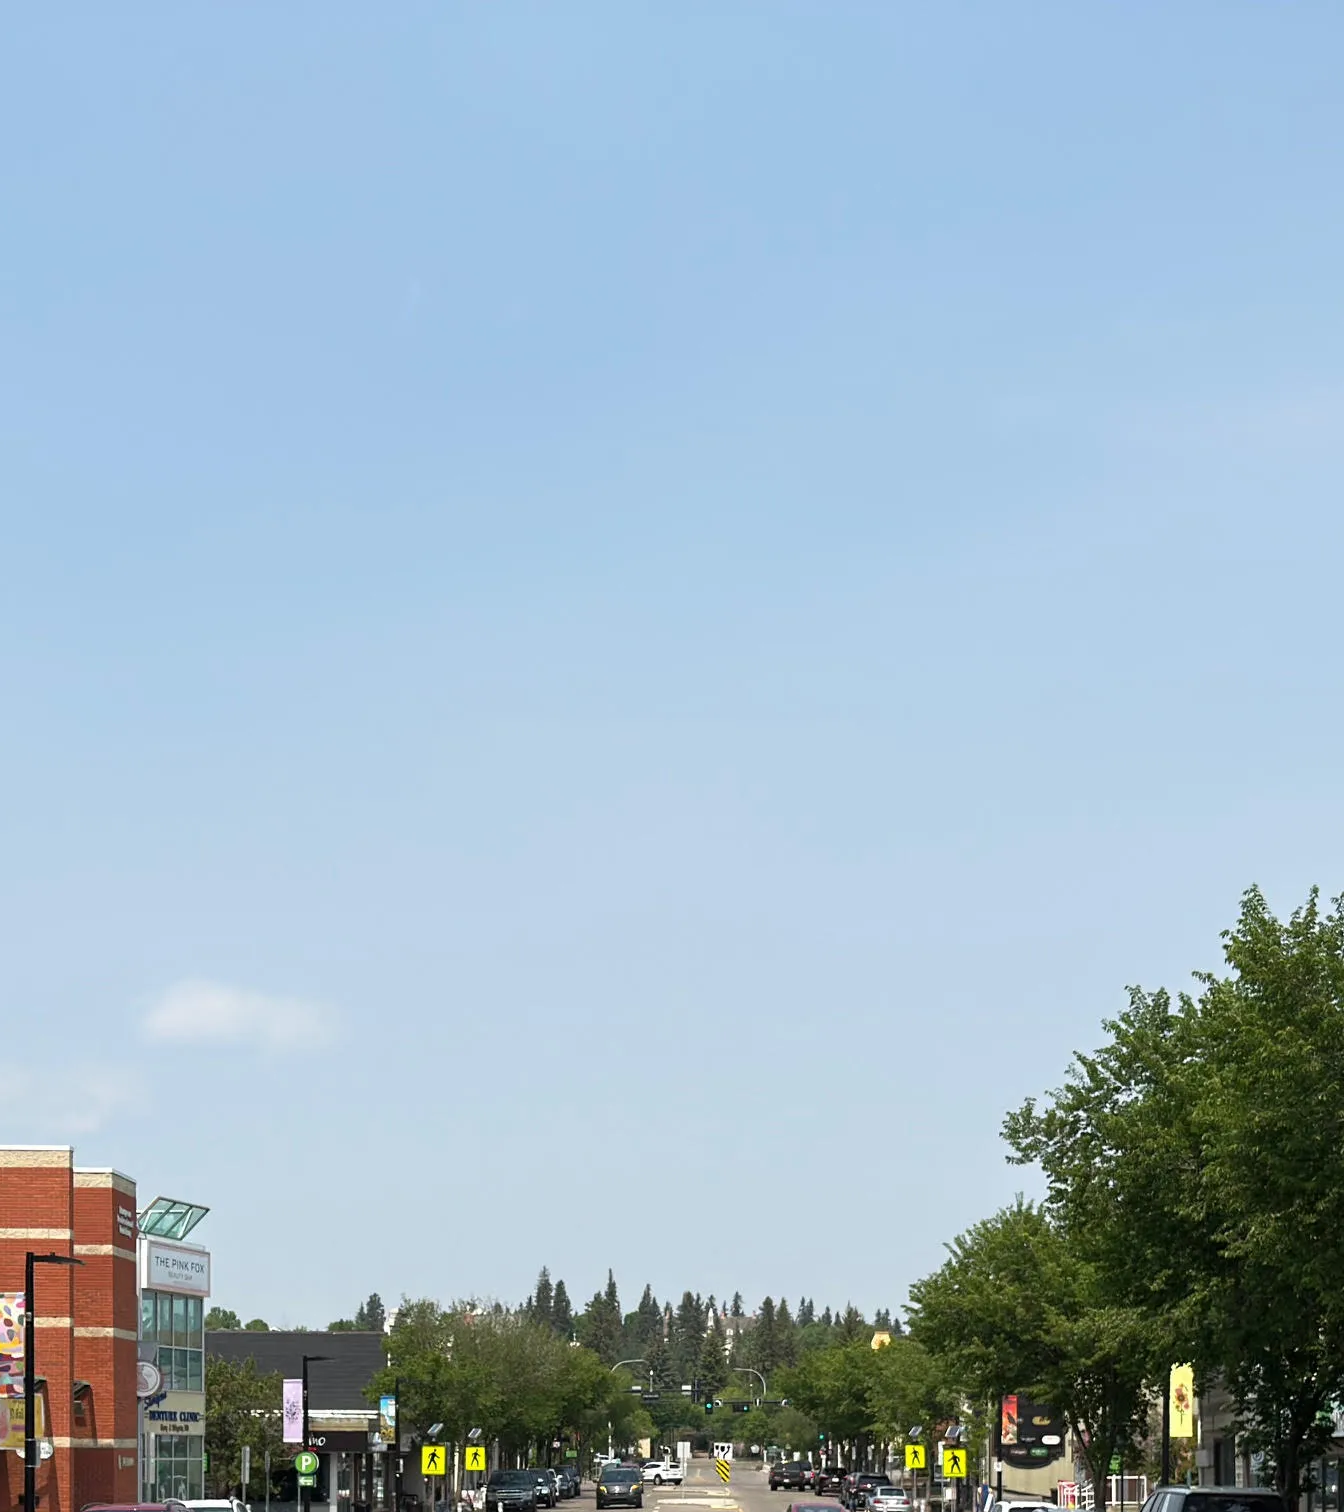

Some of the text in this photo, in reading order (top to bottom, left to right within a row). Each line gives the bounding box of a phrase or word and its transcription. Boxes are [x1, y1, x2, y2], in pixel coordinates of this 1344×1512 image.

[155, 1256, 205, 1273] THE PINK FOX
[301, 1455, 312, 1471] P
